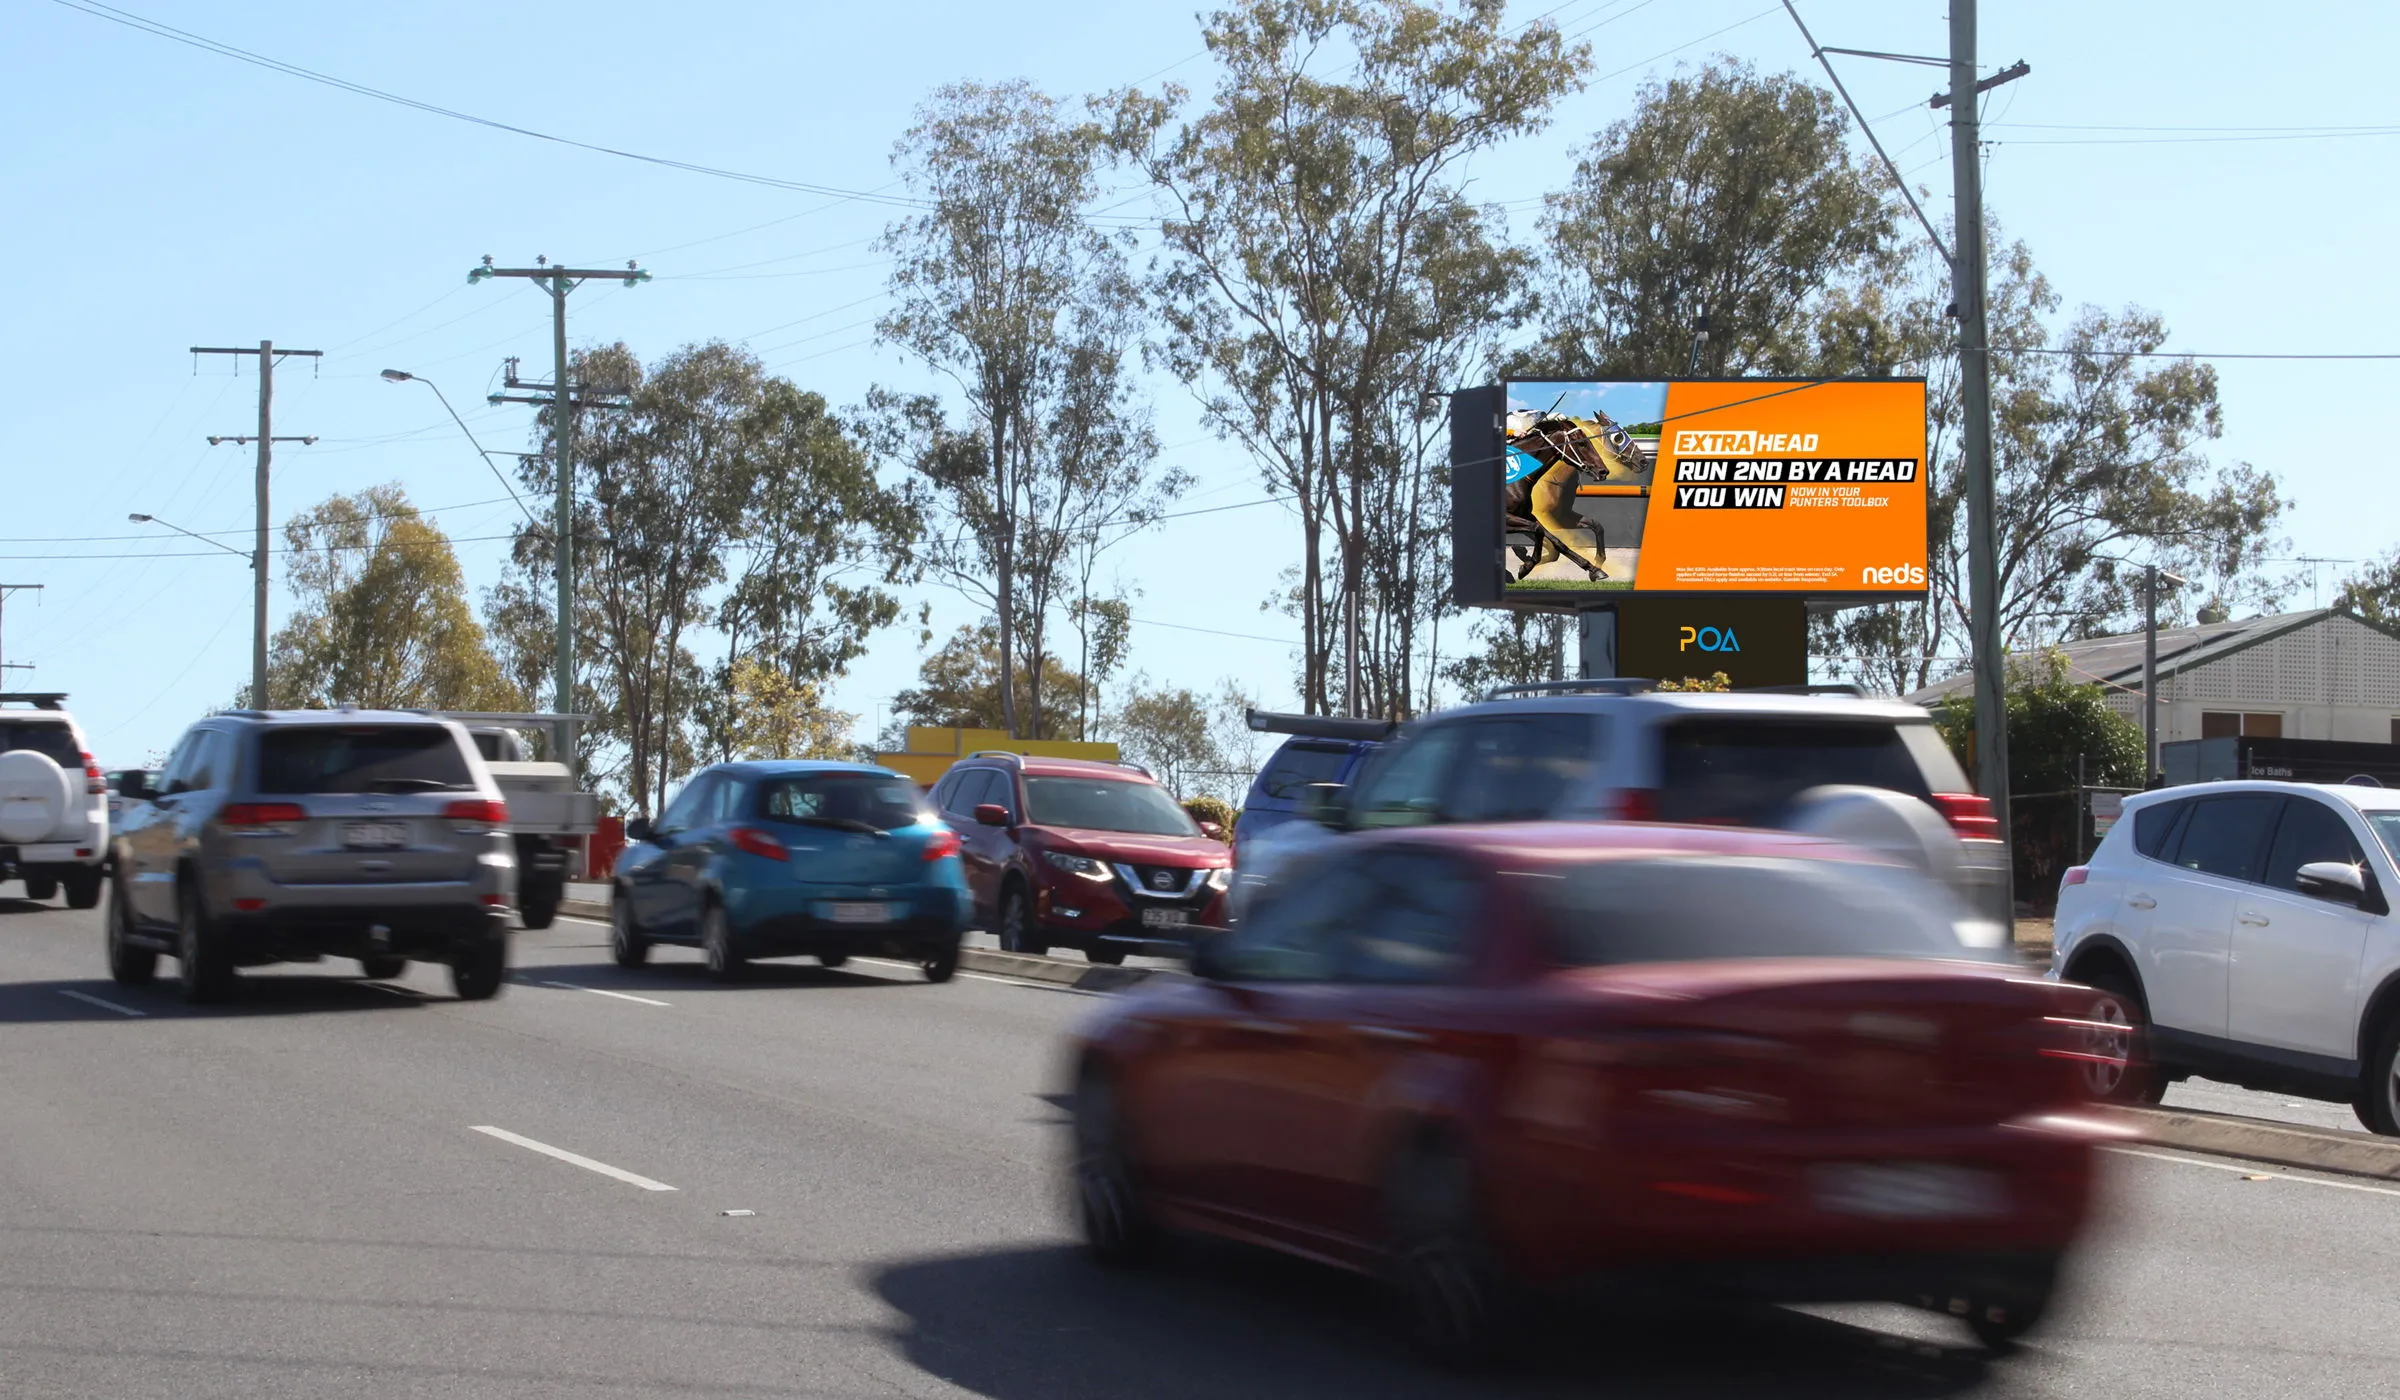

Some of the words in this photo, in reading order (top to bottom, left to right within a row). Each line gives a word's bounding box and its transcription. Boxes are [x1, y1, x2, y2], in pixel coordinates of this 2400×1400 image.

[1677, 433, 1752, 452] EXTRA
[1757, 433, 1819, 452] HEAD
[1678, 461, 1729, 481] RUN
[1733, 461, 1783, 481] 2ND
[1788, 461, 1822, 481] BY
[1823, 461, 1842, 481] A
[1847, 461, 1915, 481] HEAD
[1679, 487, 1727, 507] YOU
[1734, 487, 1784, 507] WIN
[1790, 487, 1817, 497] NOW
[1818, 487, 1830, 497] IN
[1832, 487, 1861, 497] YOUR
[1789, 497, 1839, 507] PUNTERS
[1841, 497, 1889, 507] TOOLBOX
[1862, 562, 1925, 585] neds
[1680, 626, 1741, 652] POA
[2266, 766, 2293, 777] Baths
